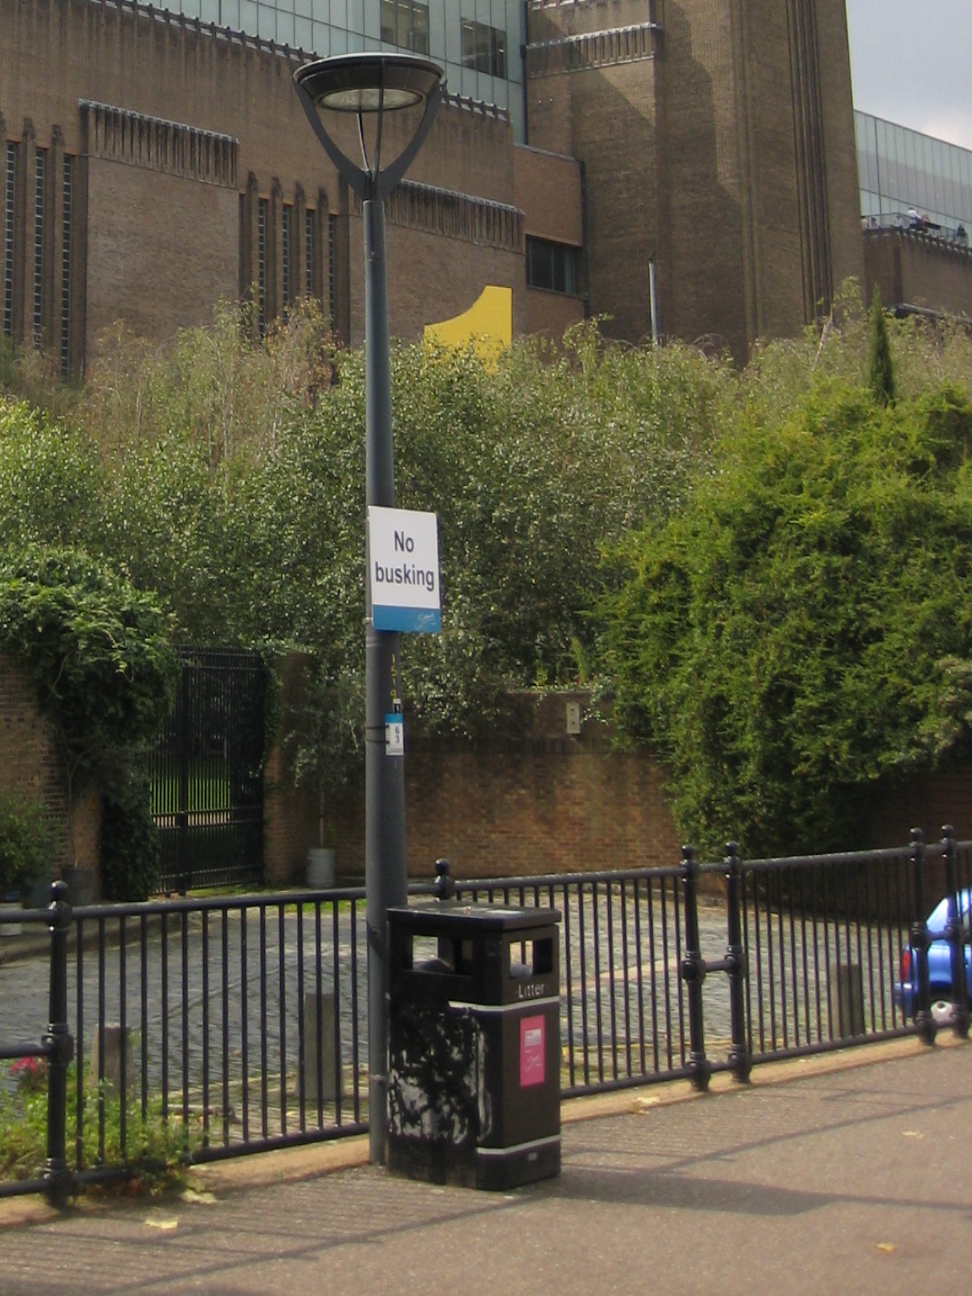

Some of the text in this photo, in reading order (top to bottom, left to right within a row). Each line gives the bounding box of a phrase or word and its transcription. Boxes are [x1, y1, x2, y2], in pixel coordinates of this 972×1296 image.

[394, 530, 414, 553] No
[375, 561, 434, 592] busking
[518, 983, 544, 999] Litter
